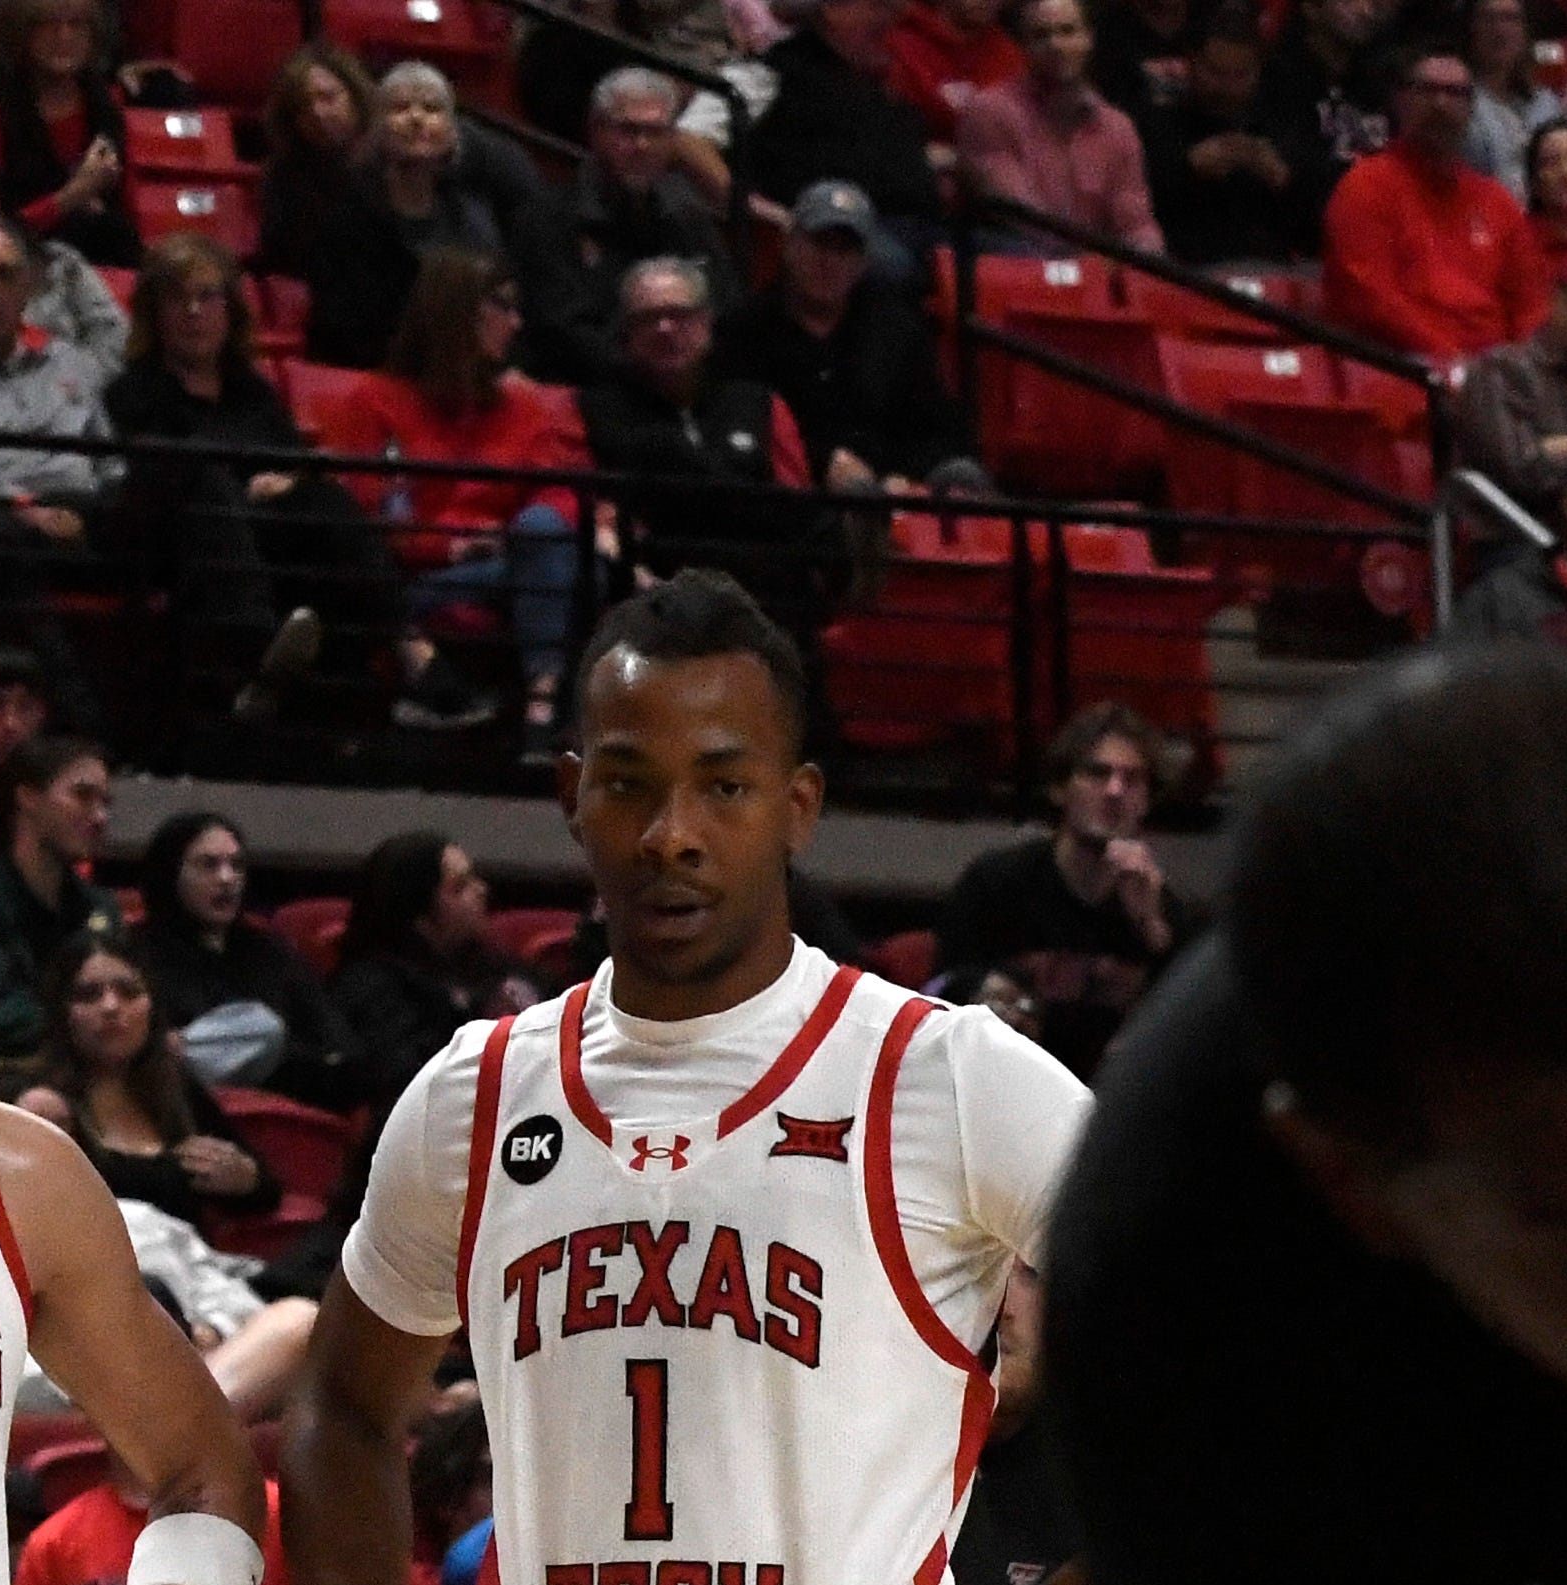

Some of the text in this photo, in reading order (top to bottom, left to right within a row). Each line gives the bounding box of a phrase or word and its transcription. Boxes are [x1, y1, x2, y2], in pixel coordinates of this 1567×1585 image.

[509, 1132, 554, 1163] BK
[504, 1220, 822, 1368] TEXAS
[624, 1359, 673, 1540] 1
